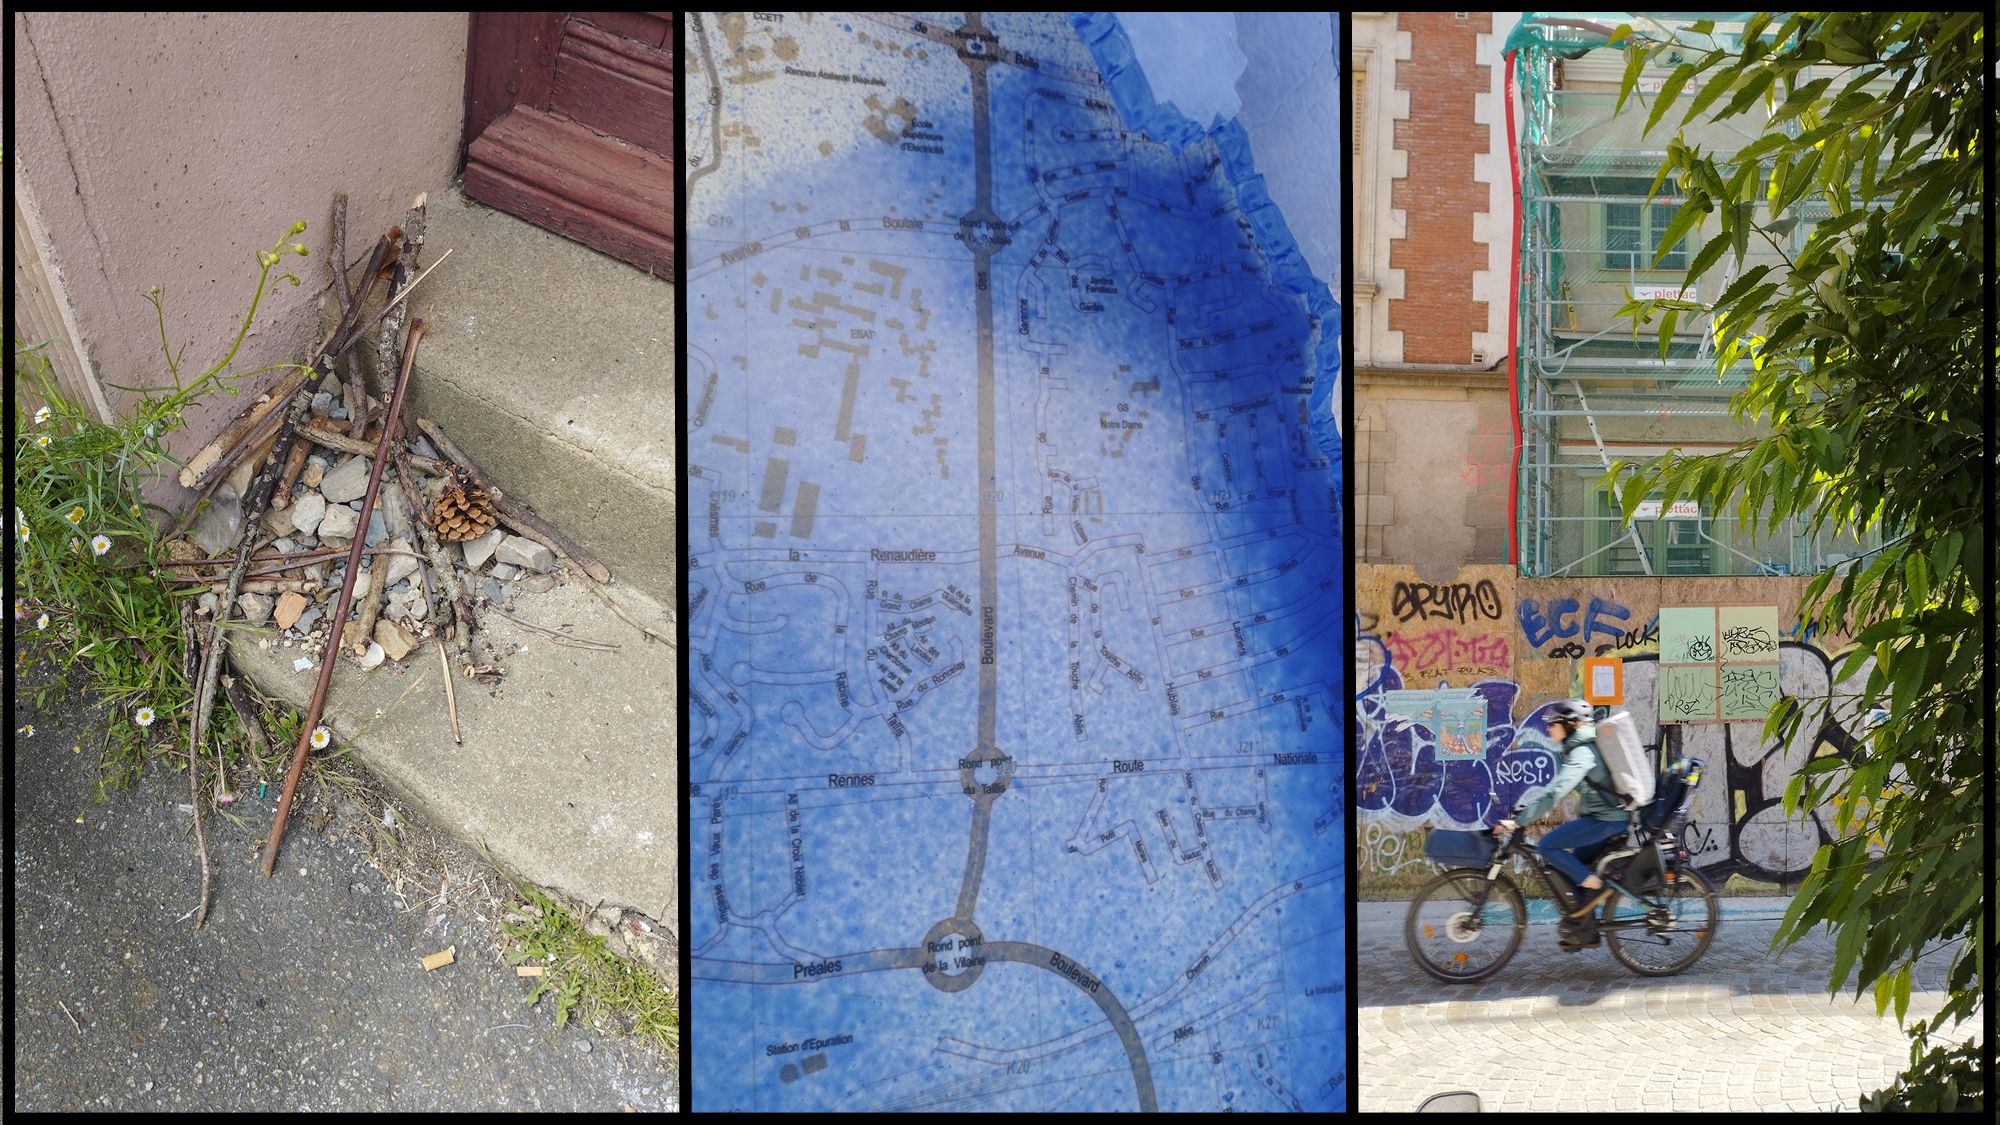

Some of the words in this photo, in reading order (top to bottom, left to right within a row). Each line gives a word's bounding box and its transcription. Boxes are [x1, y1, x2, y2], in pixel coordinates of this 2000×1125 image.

[785, 66, 816, 78] Rennes
[1652, 79, 1695, 94] plac
[707, 212, 733, 228] G19
[720, 241, 763, 266] Avenue
[795, 225, 811, 240] de
[838, 219, 851, 231] la
[882, 216, 924, 231] Boulaie
[1019, 298, 1029, 336] Garenne
[1116, 402, 1130, 413] GS
[1101, 420, 1120, 430] Notre
[1121, 420, 1143, 430] Dame
[1655, 503, 1697, 516] pettac
[789, 547, 800, 562] la
[870, 548, 937, 562] Renaudière
[1013, 544, 1046, 561] Avenue
[867, 579, 878, 600] Rue
[1069, 576, 1080, 607] Chemin
[1083, 578, 1099, 592] Rue
[1090, 603, 1099, 614] de
[1070, 613, 1080, 625] de
[744, 579, 767, 594] Rue
[804, 572, 818, 584] de
[836, 671, 850, 708] Rabine
[981, 605, 995, 666] Boulevard
[1094, 630, 1102, 639] la
[1070, 640, 1080, 649] la
[867, 648, 877, 661] du
[1099, 644, 1121, 669] Touche
[1071, 661, 1080, 690] Touche
[1197, 669, 1213, 680] Rue
[917, 683, 929, 693] du
[1165, 682, 1179, 717] Hublais
[1209, 709, 1225, 721] Rue
[1236, 741, 1254, 754] J21
[958, 757, 983, 770] Rond
[990, 755, 1013, 768] point
[1113, 759, 1144, 774] Route
[1273, 752, 1318, 767] Nationale
[828, 773, 875, 788] Rennes
[789, 810, 799, 821] de
[791, 824, 799, 835] la
[710, 832, 721, 857] Vaux
[791, 837, 802, 868] Croix
[709, 862, 719, 881] des
[928, 939, 953, 954] Rond
[958, 934, 982, 951] point
[922, 962, 936, 974] de
[938, 960, 948, 971] la
[953, 954, 986, 969] Vilaine
[1185, 954, 1211, 980] Chemin
[793, 959, 843, 980] Préales
[1048, 951, 1102, 994] Boulevard
[766, 1043, 799, 1057] Station
[801, 1033, 854, 1052] d'Epuration
[1006, 1058, 1031, 1076] K20
